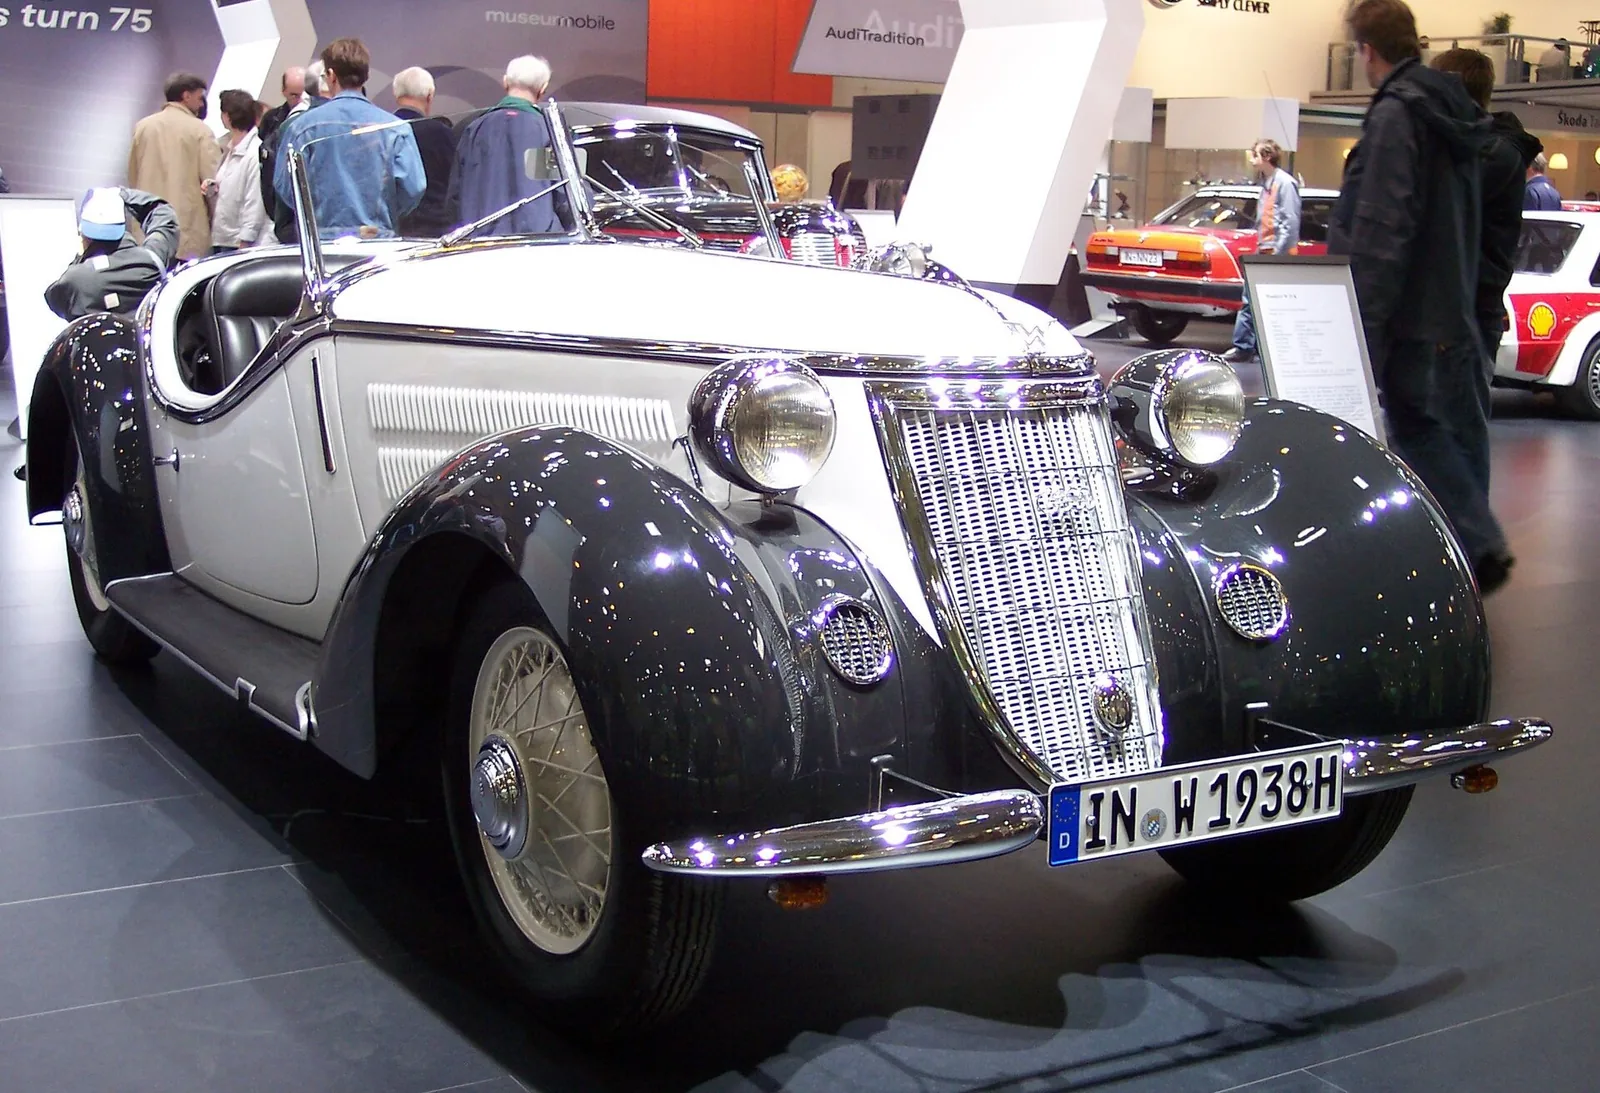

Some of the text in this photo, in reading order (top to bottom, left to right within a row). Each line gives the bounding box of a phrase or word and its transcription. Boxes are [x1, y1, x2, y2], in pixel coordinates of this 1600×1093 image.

[21, 4, 99, 31] turn
[109, 7, 152, 33] 75
[1233, 0, 1270, 14] CLEVER
[825, 26, 925, 47] AudiTradition
[1059, 832, 1070, 849] D
[1085, 787, 1137, 850] IN
